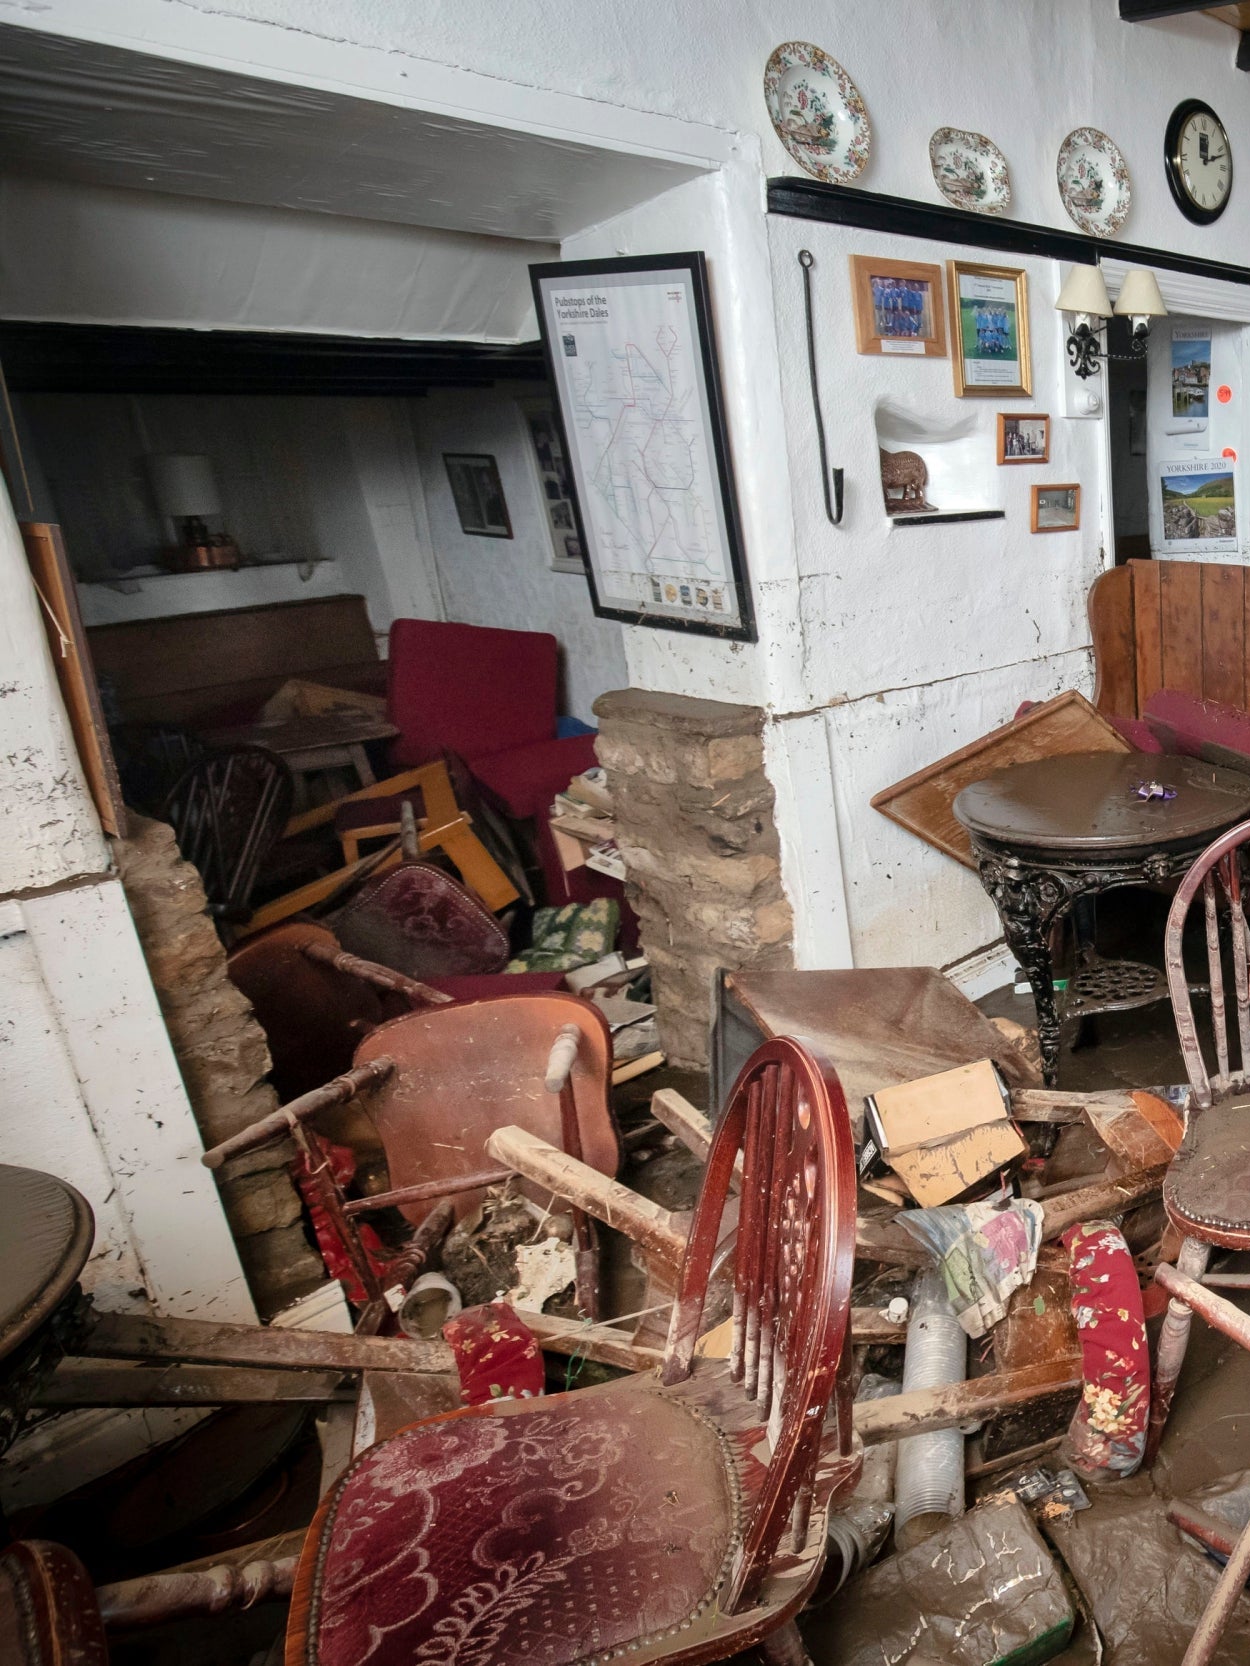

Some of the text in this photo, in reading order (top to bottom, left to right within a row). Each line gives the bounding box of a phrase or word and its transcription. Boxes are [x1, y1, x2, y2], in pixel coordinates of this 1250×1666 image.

[555, 294, 607, 308] Pubstops of the
[557, 307, 609, 319] Yorkshire Dales
[1174, 330, 1209, 338] YORKSHIRE
[1166, 462, 1227, 473] YORKSHIRE 2020
